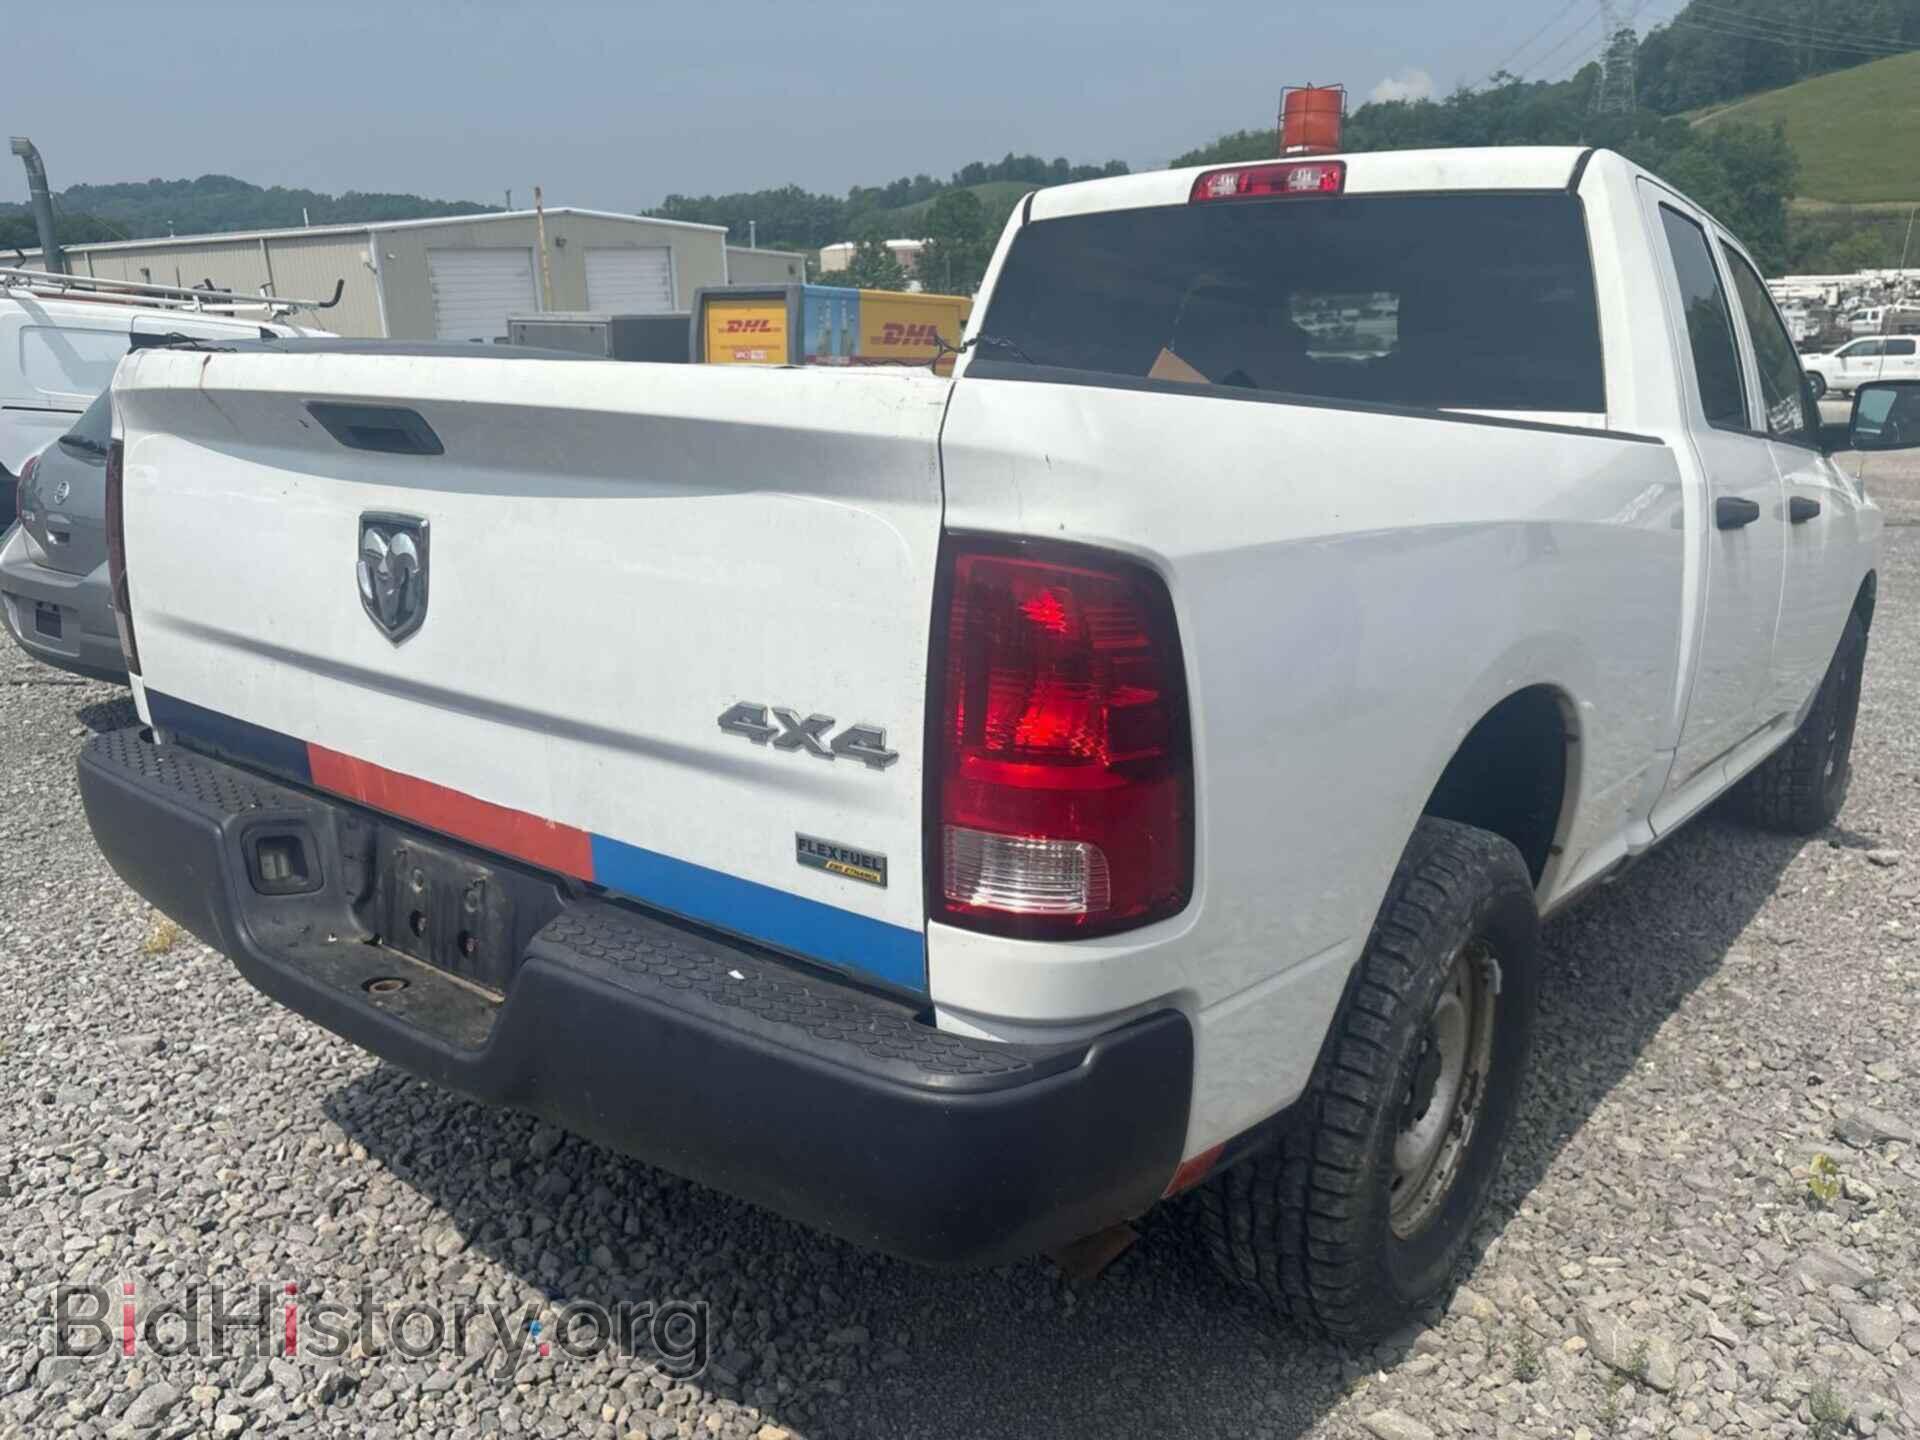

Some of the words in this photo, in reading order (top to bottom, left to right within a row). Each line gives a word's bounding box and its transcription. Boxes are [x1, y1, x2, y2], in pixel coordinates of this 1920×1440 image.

[727, 319, 771, 333] DHL
[882, 322, 938, 346] DHL
[799, 838, 882, 871] FLEXFUEL
